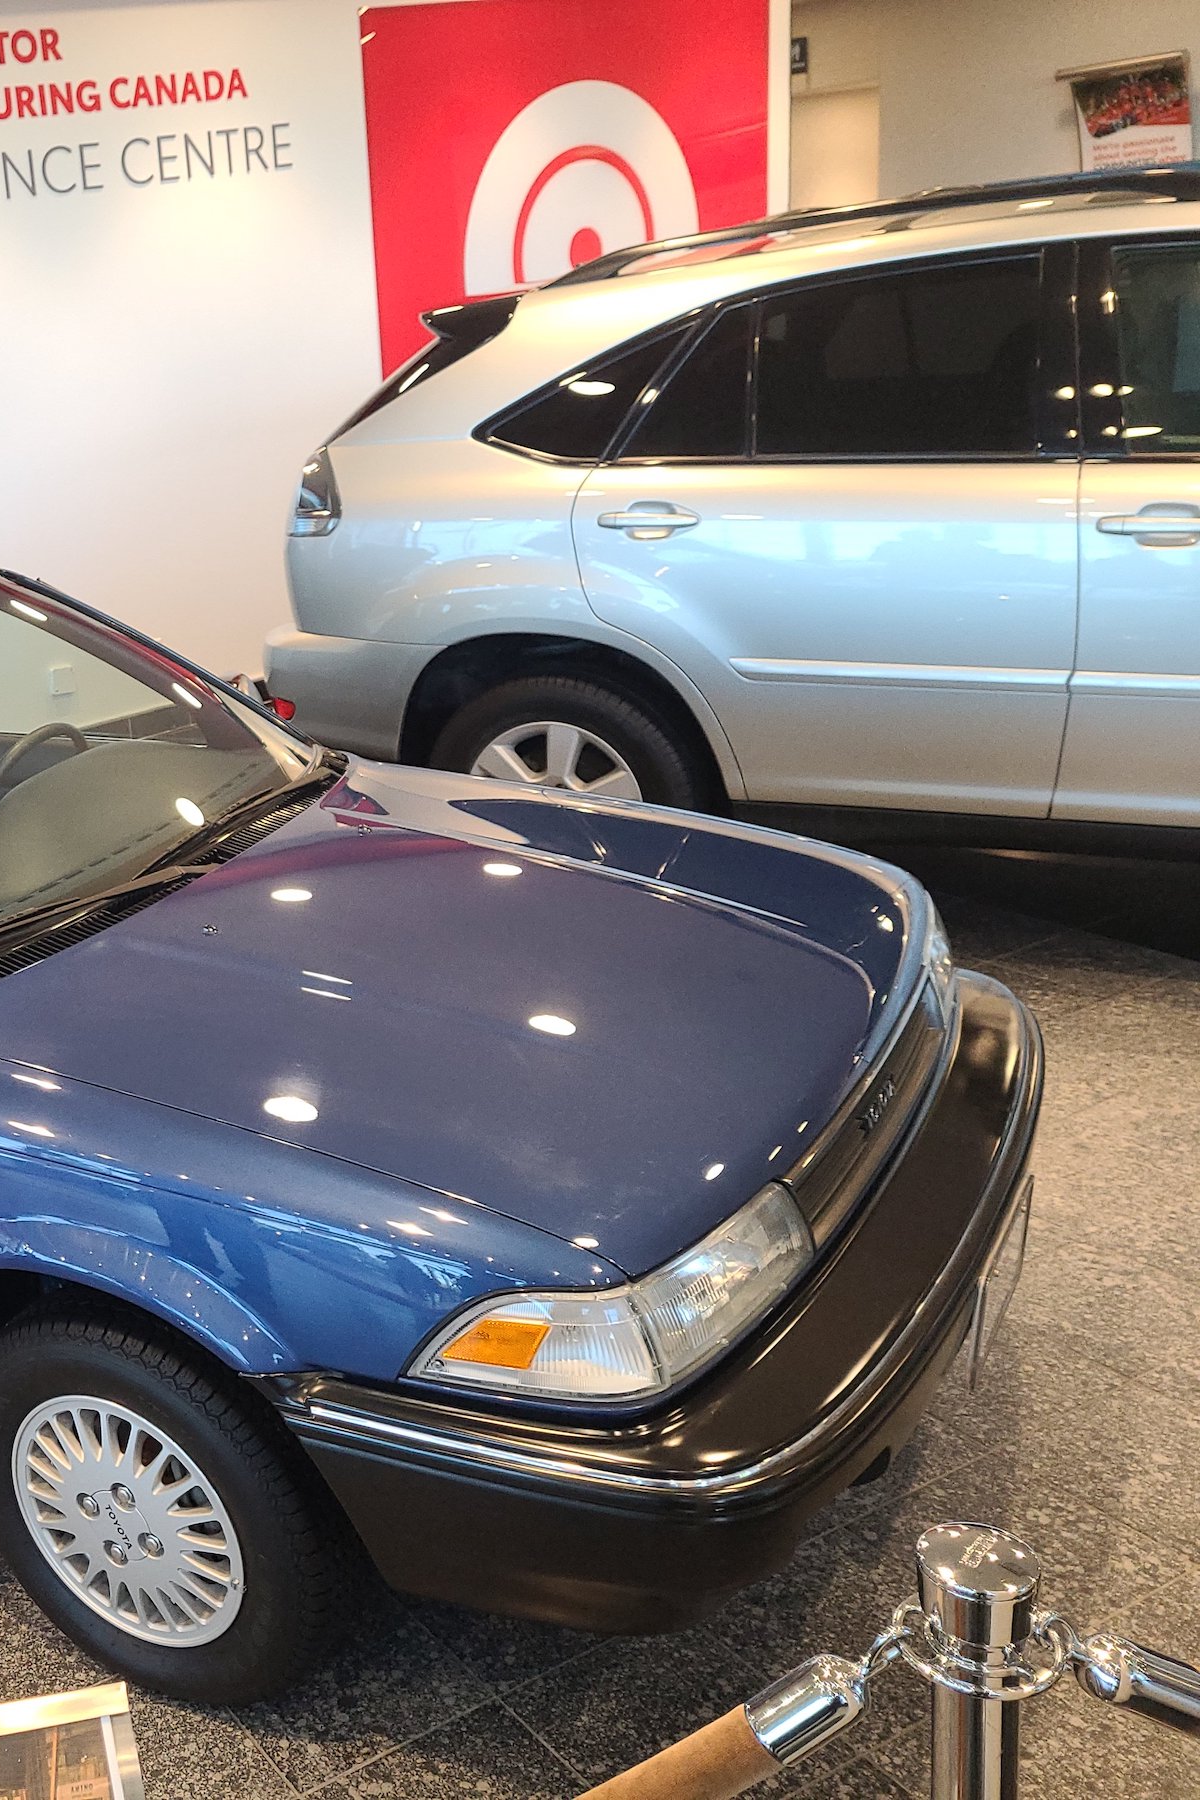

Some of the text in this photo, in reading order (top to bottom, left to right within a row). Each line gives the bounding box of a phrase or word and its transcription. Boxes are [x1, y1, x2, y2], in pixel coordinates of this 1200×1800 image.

[110, 69, 247, 108] CANADA
[121, 123, 294, 185] CENTRE
[105, 1504, 133, 1550] TOYOTA
